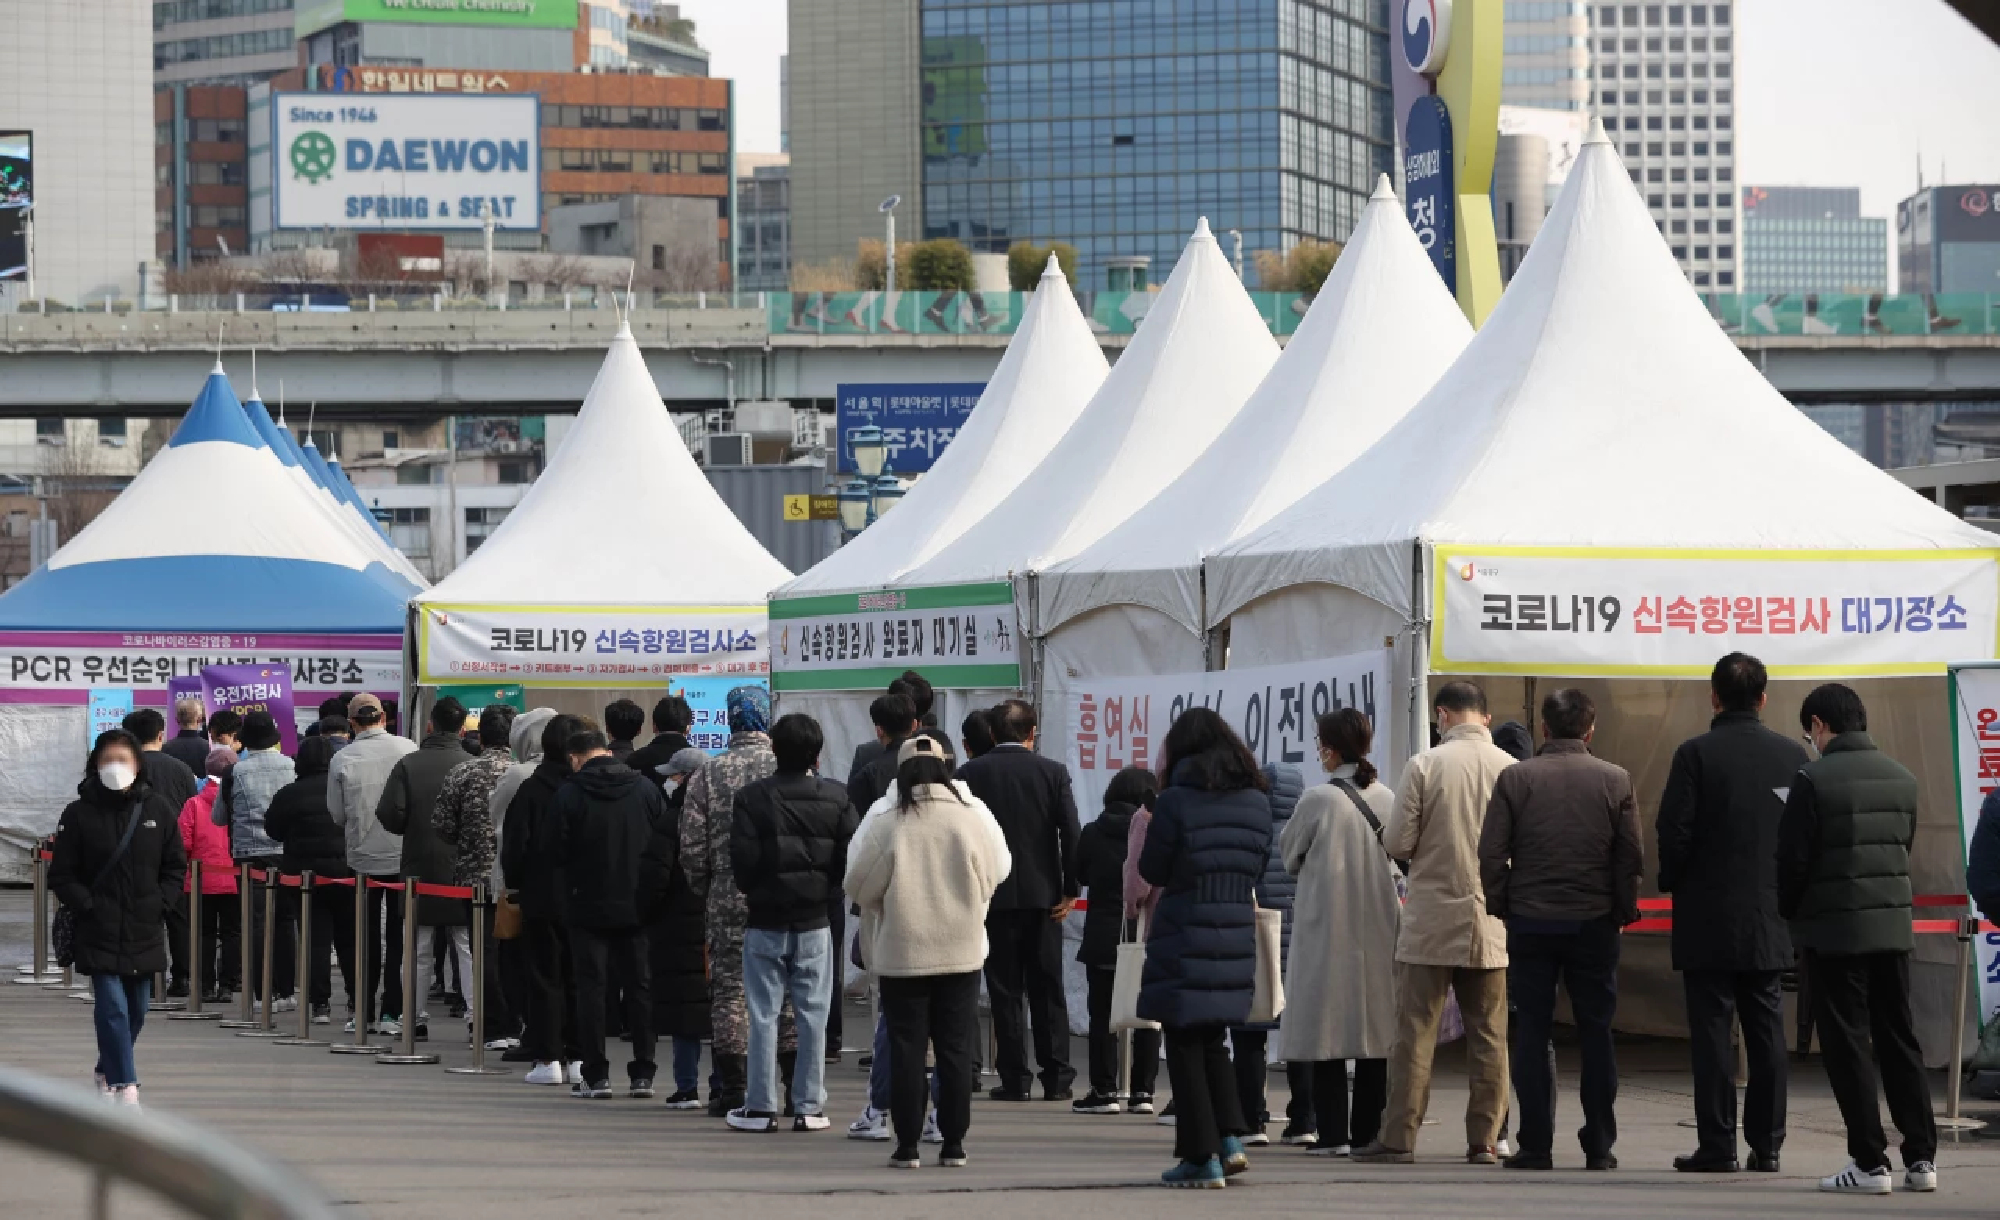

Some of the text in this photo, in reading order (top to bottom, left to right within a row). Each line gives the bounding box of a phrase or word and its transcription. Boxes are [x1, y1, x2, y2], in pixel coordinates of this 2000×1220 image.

[289, 107, 378, 123] Since 1946
[345, 139, 529, 173] DAEWON
[345, 197, 428, 218] SPRING
[1481, 594, 1967, 635] 코로나19 신속항원검사 대기장소
[491, 628, 757, 654] 코로나19 신속항원검사소
[800, 620, 876, 662] 신속항원검사
[883, 618, 924, 659] 완료자
[933, 614, 978, 656] 대기실
[11, 655, 72, 682] PCR
[82, 656, 178, 684] 우선순위
[270, 657, 364, 684] 사장소
[213, 683, 281, 705] 유전자검사
[1077, 693, 1150, 770] 흡연실
